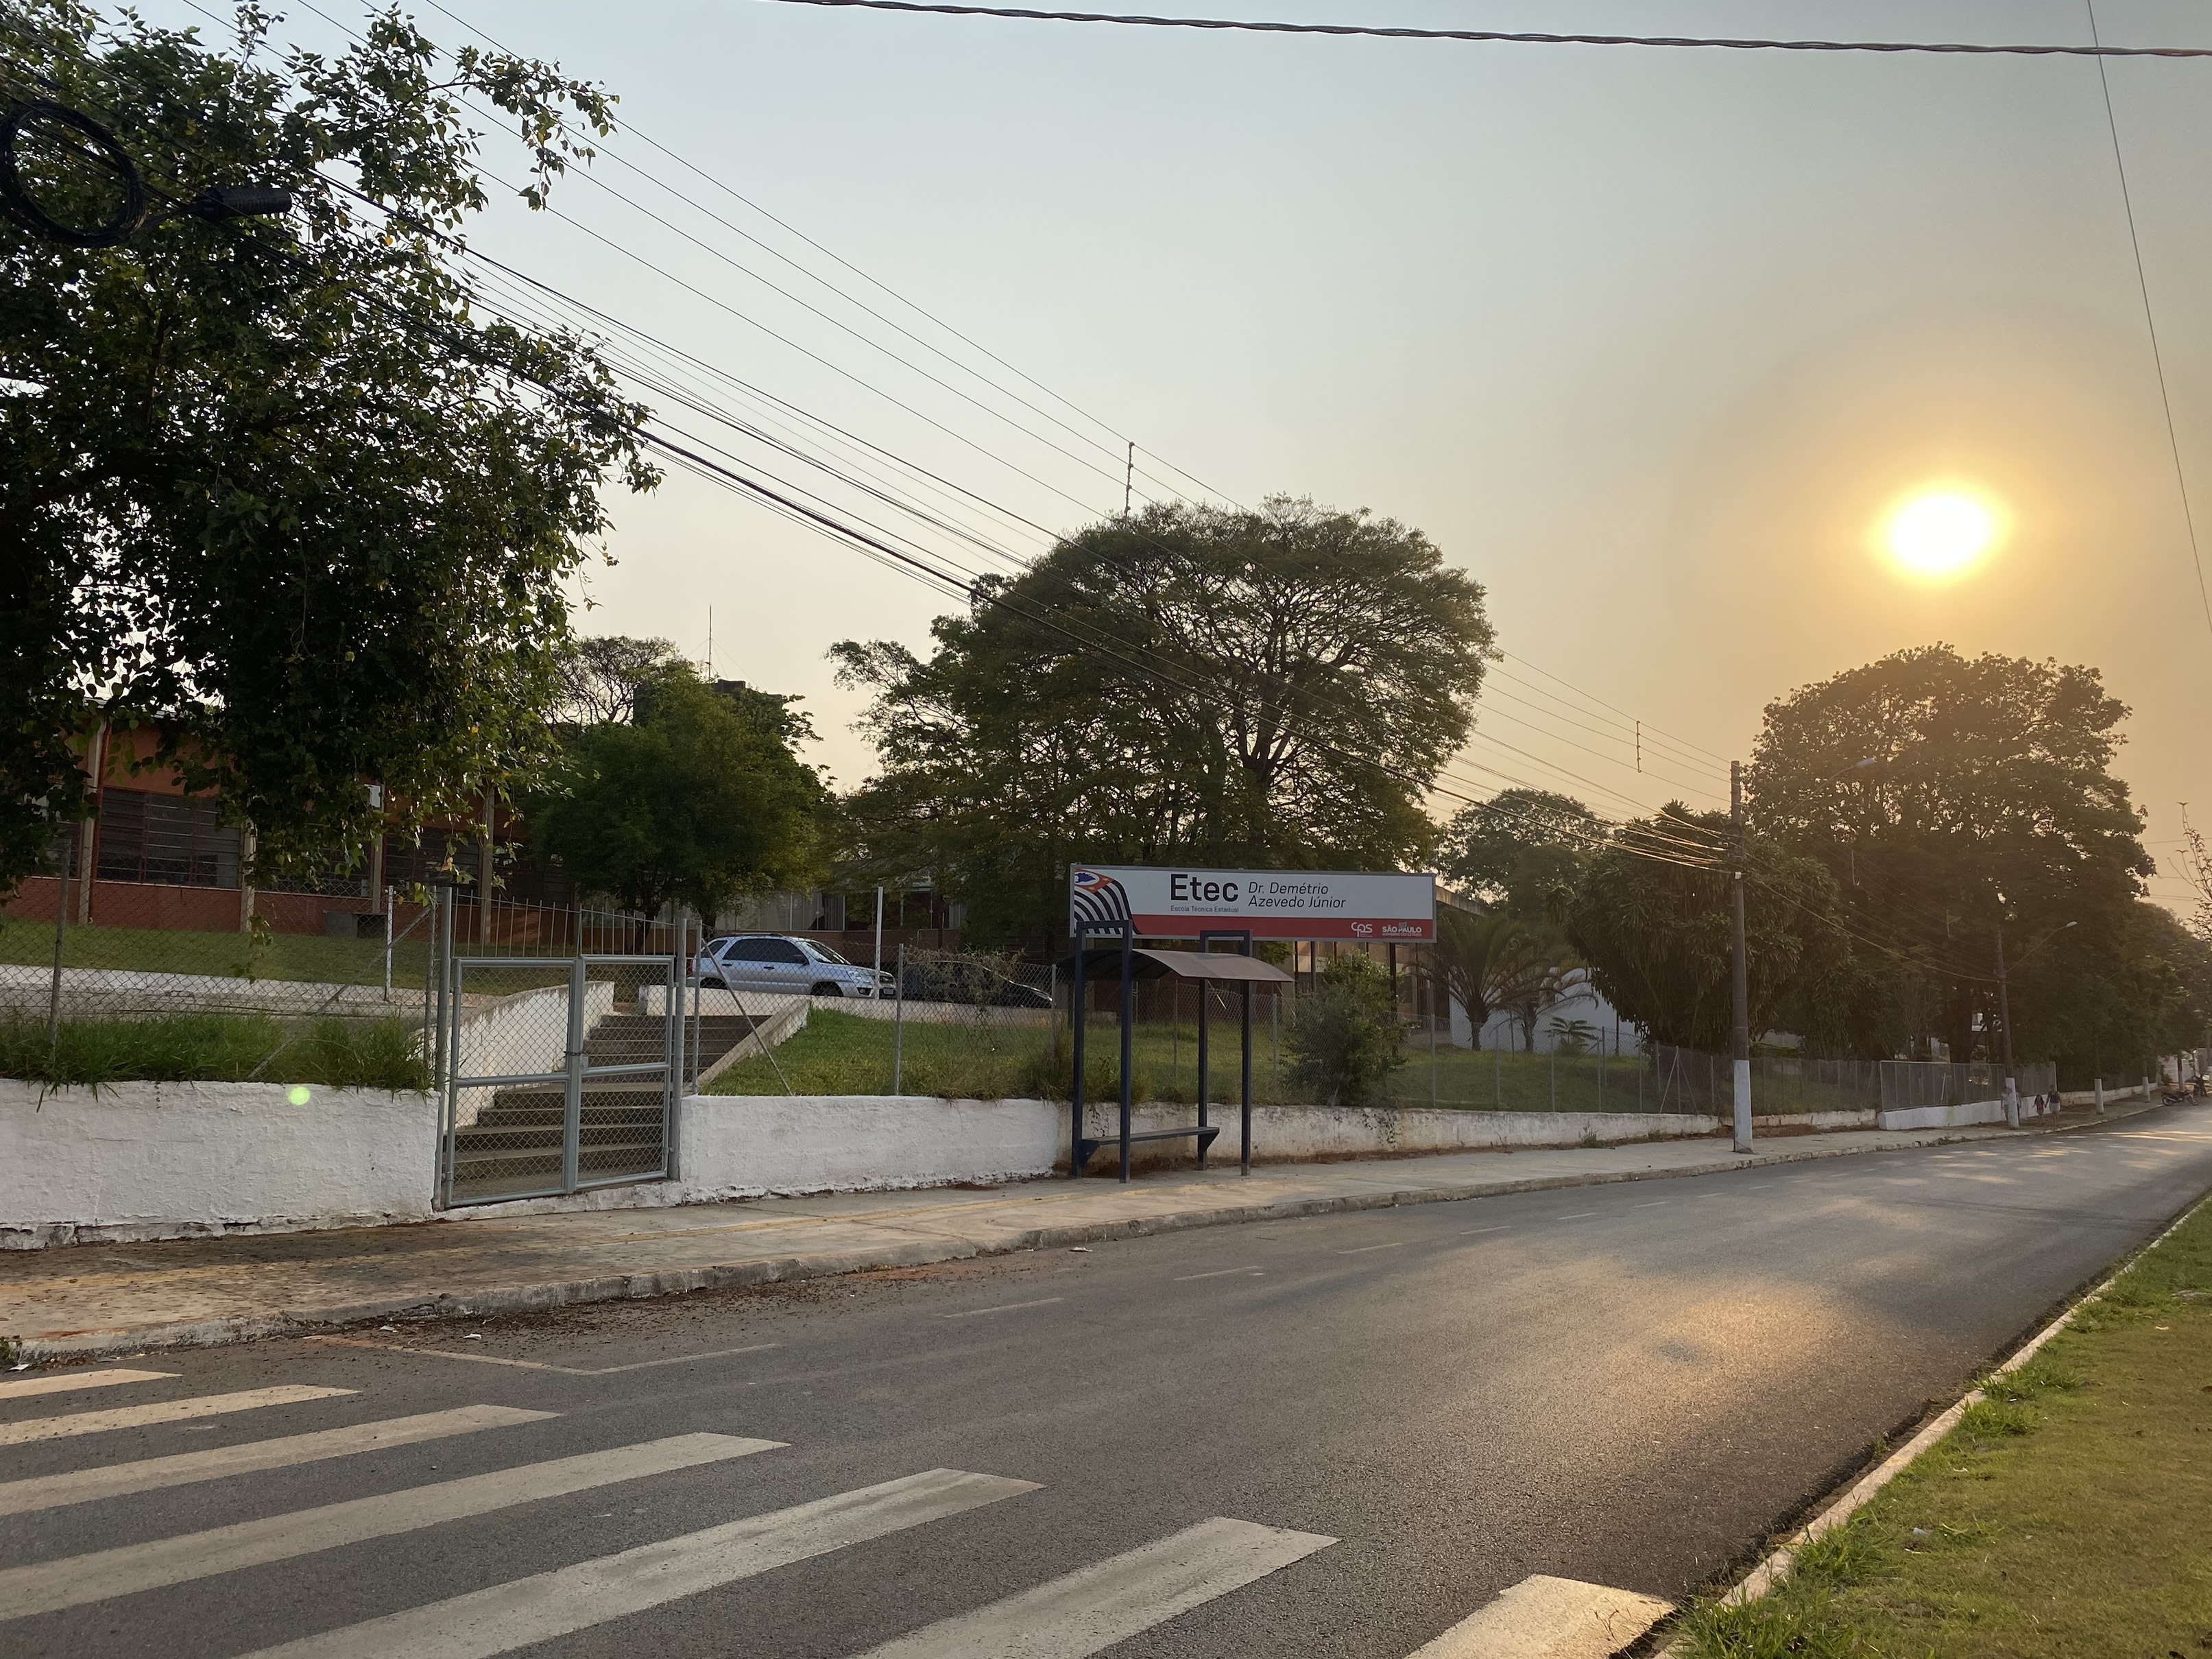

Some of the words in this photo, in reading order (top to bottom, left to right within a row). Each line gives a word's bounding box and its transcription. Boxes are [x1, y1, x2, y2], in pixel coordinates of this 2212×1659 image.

[1170, 874, 1238, 902] Etec
[1248, 881, 1264, 894] Dr.
[1269, 882, 1329, 895] Demétrio
[1248, 895, 1305, 907] Azevedo
[1308, 896, 1347, 908] Júnior
[1382, 924, 1397, 933] SÃO
